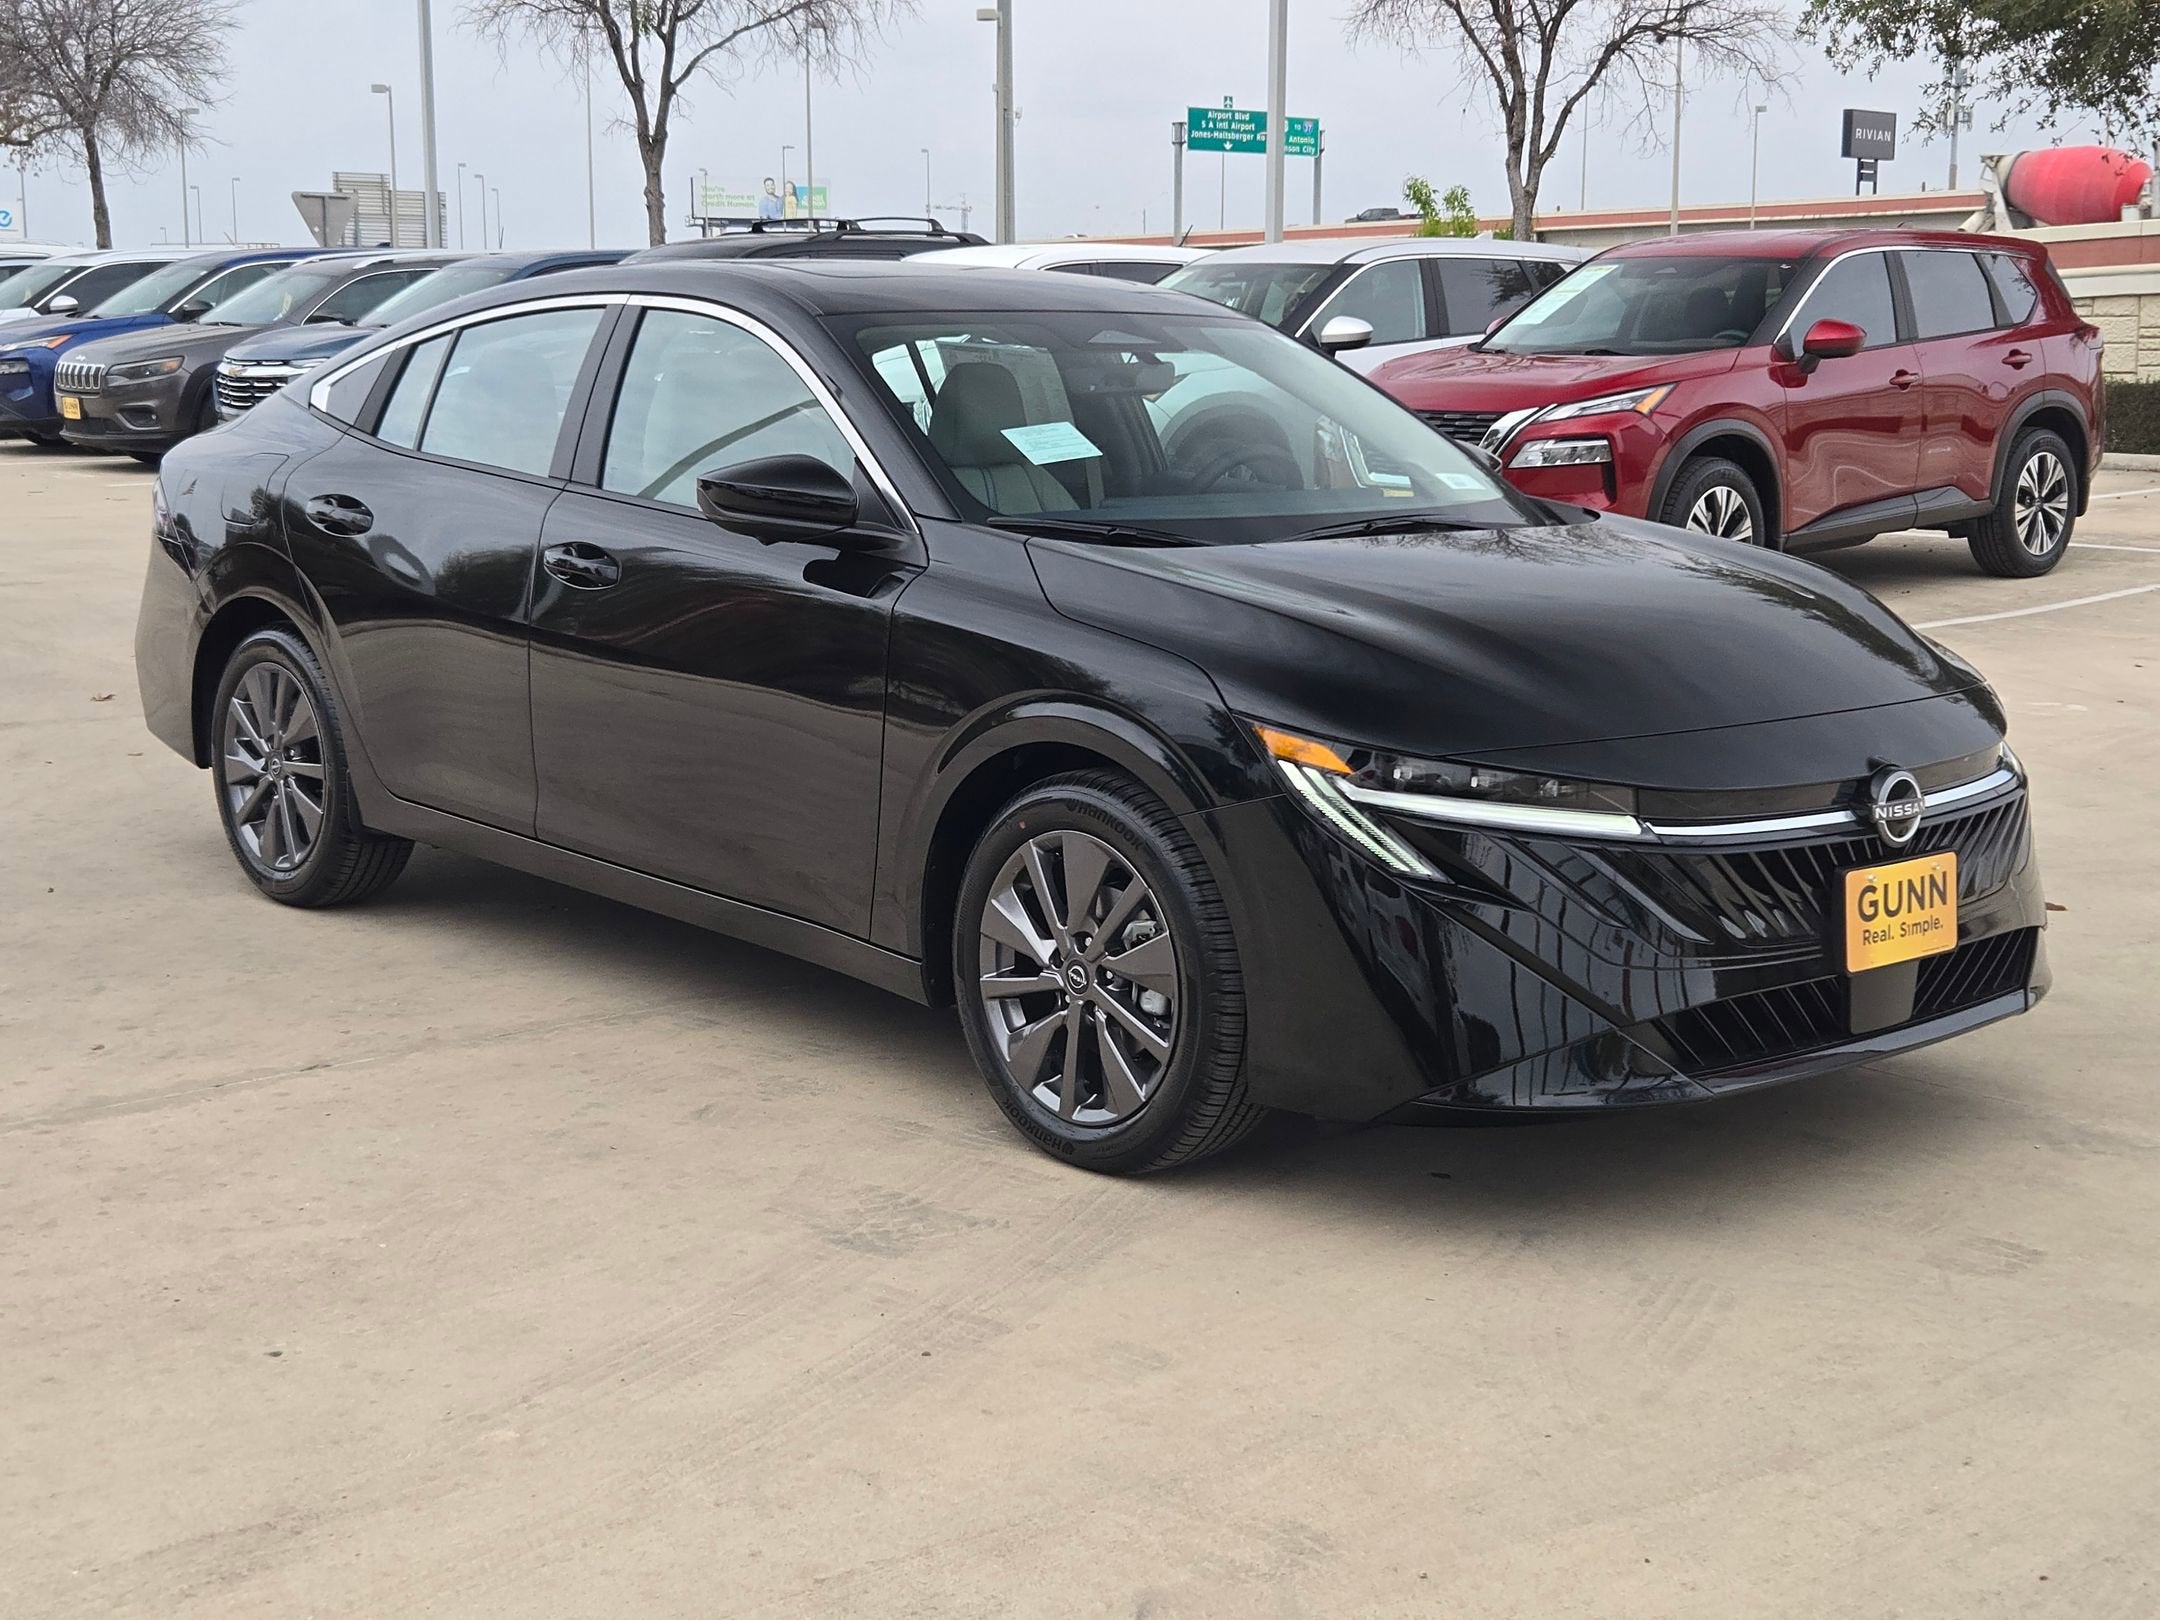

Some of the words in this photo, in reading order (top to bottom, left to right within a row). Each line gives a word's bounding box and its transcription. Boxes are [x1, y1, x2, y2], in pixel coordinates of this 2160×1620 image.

[1208, 111, 1232, 120] Airport
[1235, 112, 1250, 121] Blvd
[1201, 120, 1206, 128] S
[1231, 122, 1255, 132] Airport
[1289, 136, 1315, 144] Antonio
[1855, 128, 1892, 142] RIVIAN
[1302, 145, 1315, 155] City
[1857, 871, 1948, 923] GUNN
[1862, 924, 1895, 946] Real.
[1899, 914, 1944, 938] Simple.
